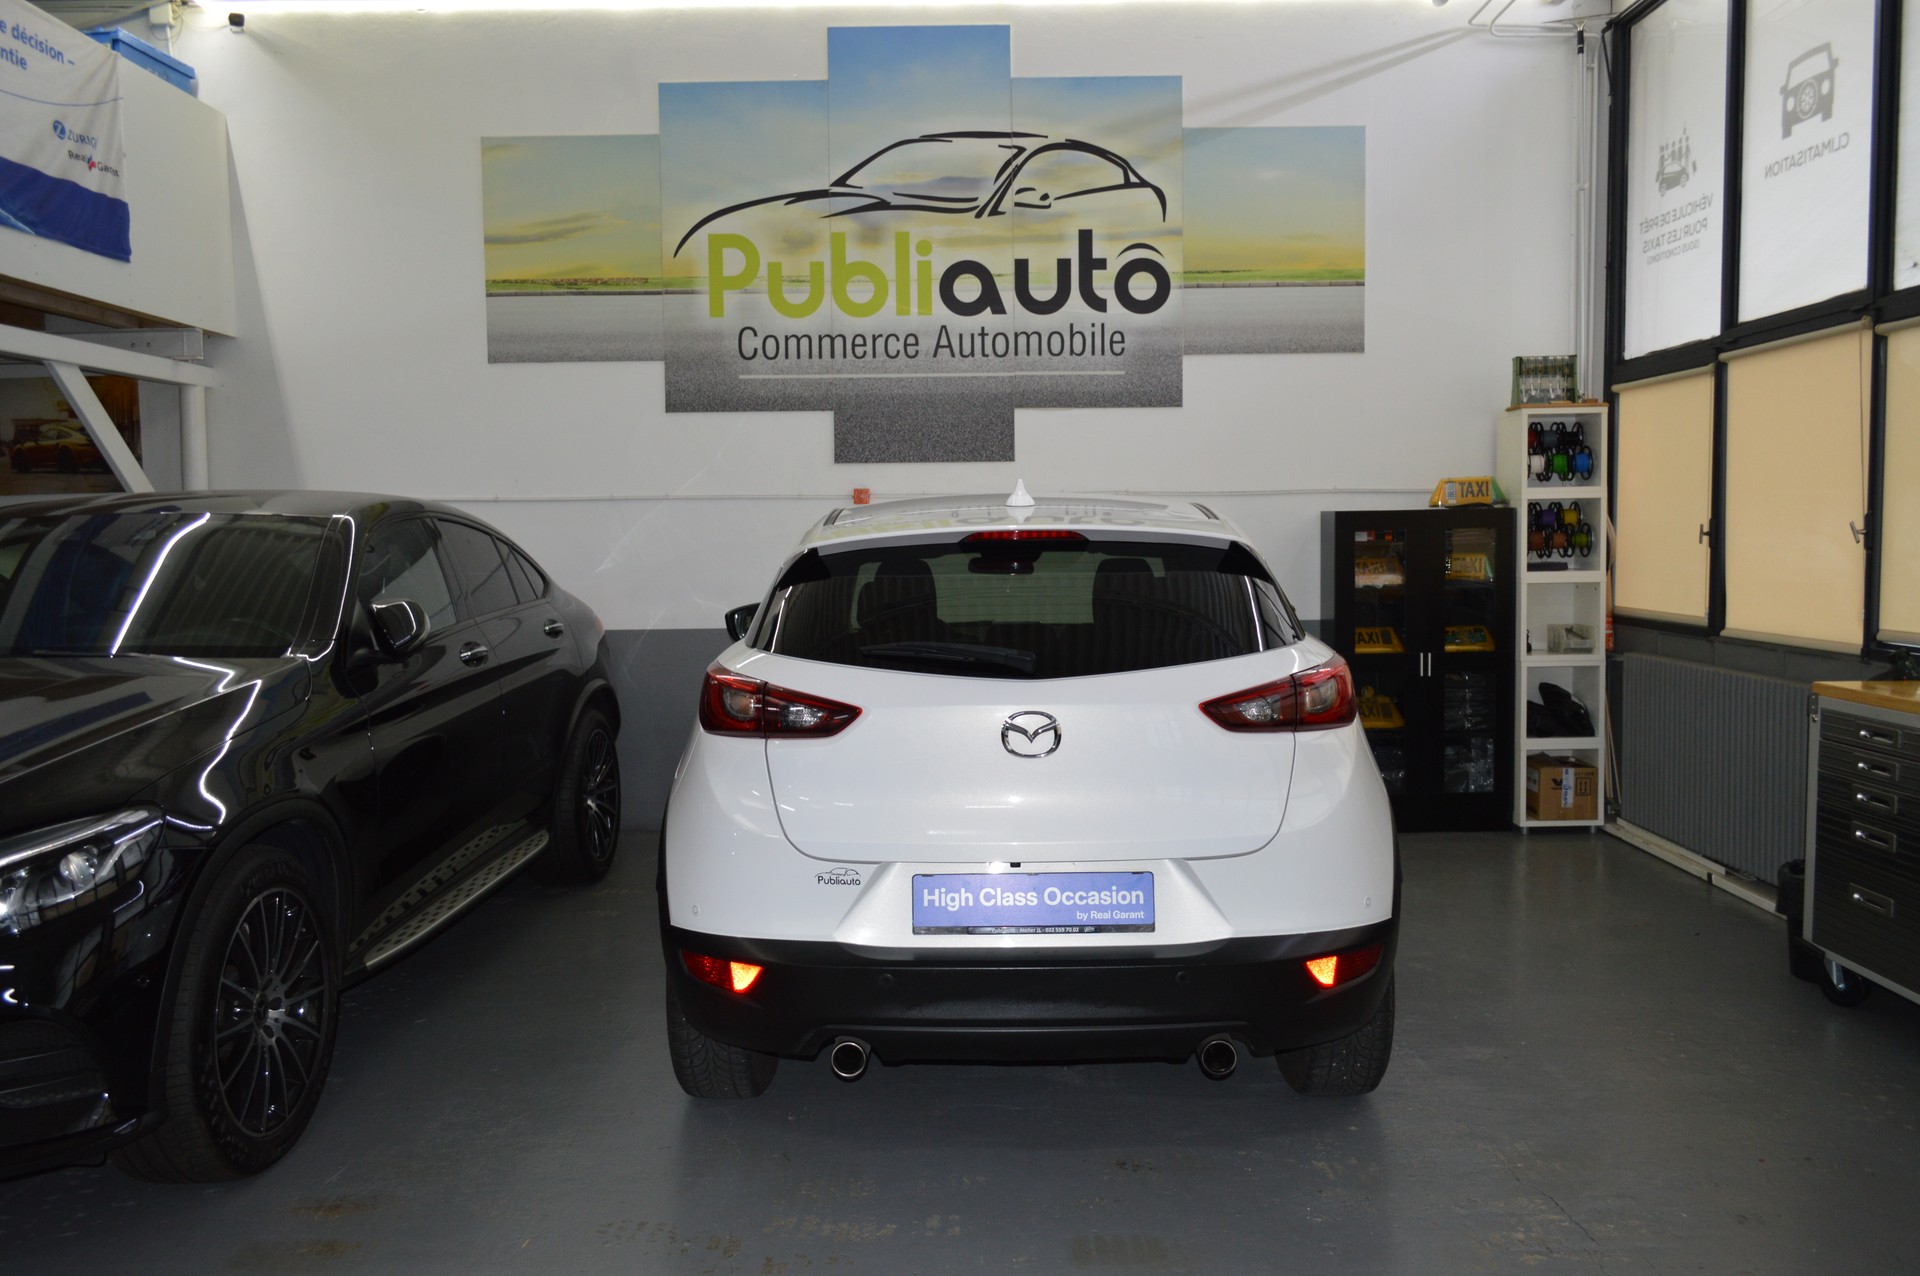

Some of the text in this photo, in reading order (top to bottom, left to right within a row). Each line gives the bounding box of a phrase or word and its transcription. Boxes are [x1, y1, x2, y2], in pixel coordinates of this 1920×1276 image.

[11, 23, 65, 64] décision
[707, 229, 1171, 319] Publiauto
[737, 322, 1127, 361] Commerce Automobile
[1458, 481, 1489, 498] TAXI
[1354, 631, 1380, 645] AXI
[817, 875, 861, 886] Publiauto
[923, 886, 1144, 912] High Class Occasion
[1076, 910, 1144, 921] by Real Garant
